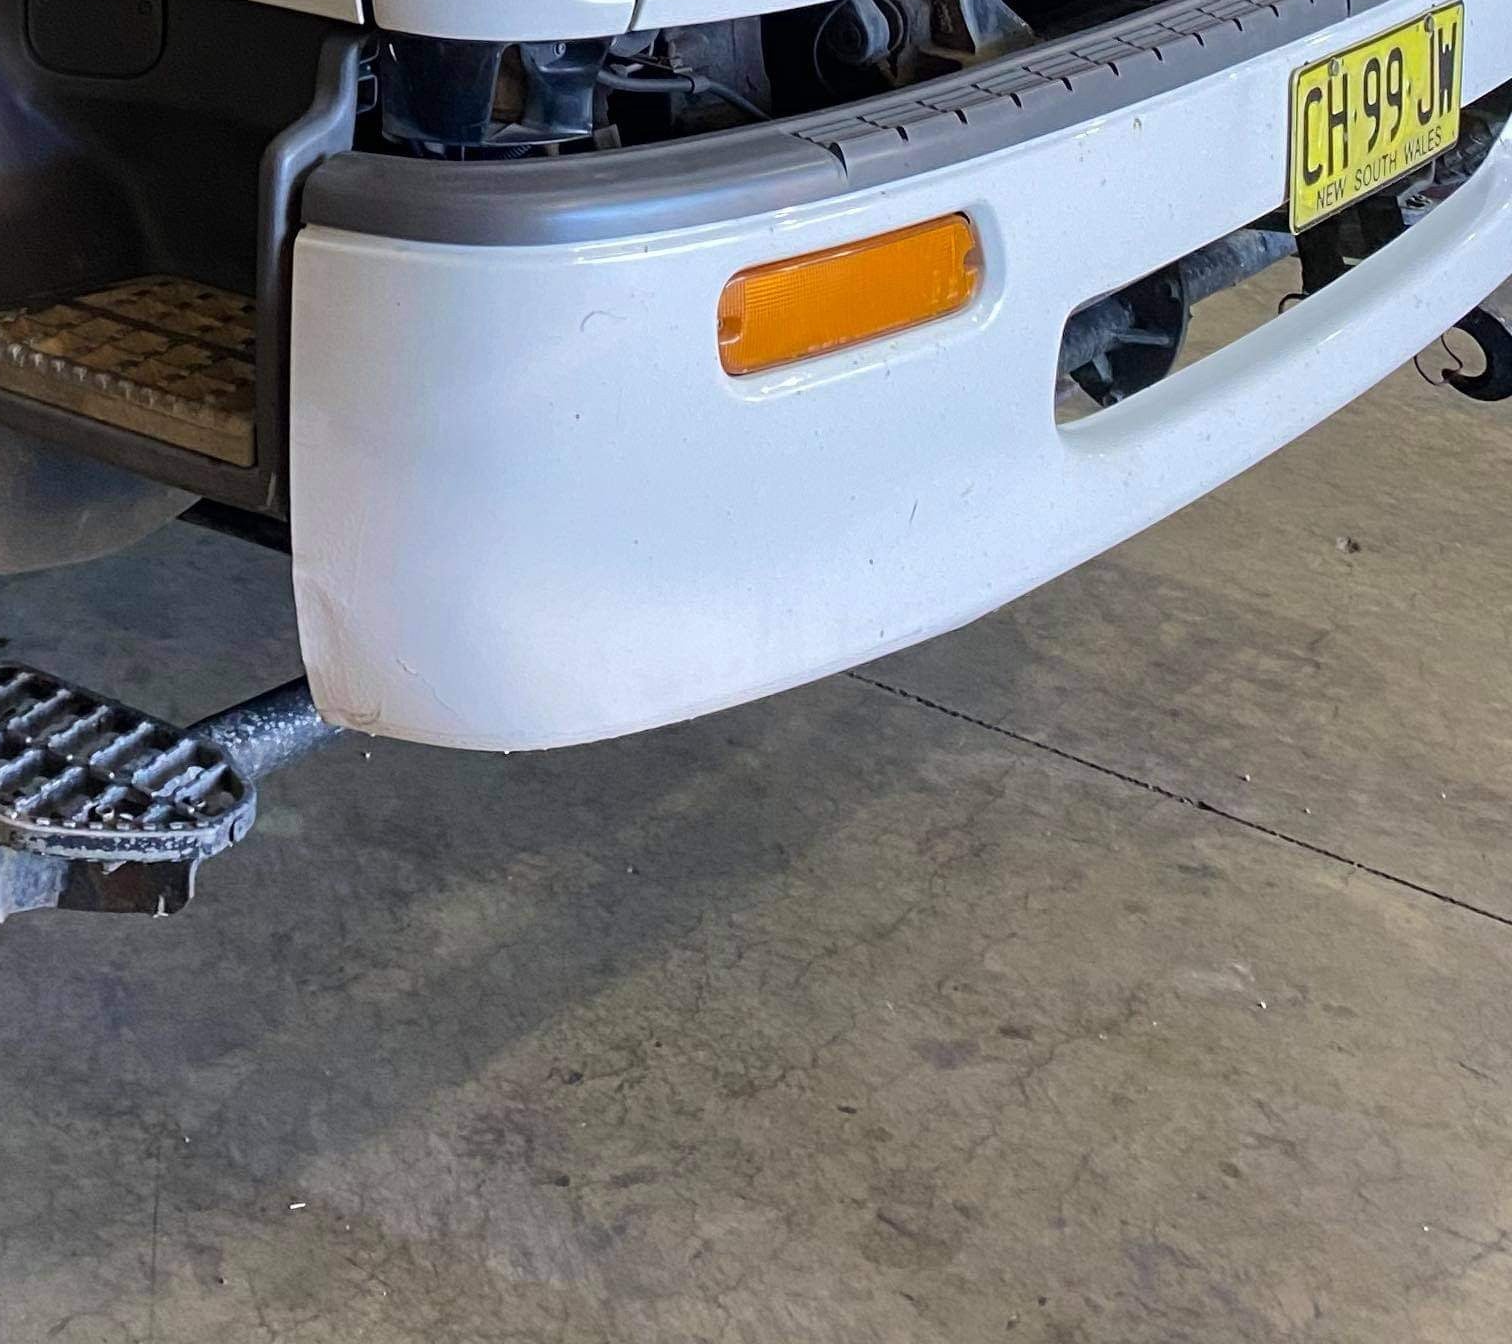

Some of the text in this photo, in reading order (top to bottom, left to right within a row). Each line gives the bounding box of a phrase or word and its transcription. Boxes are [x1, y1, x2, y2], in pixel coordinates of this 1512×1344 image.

[1316, 125, 1442, 211] NEW SOUTH WALES
